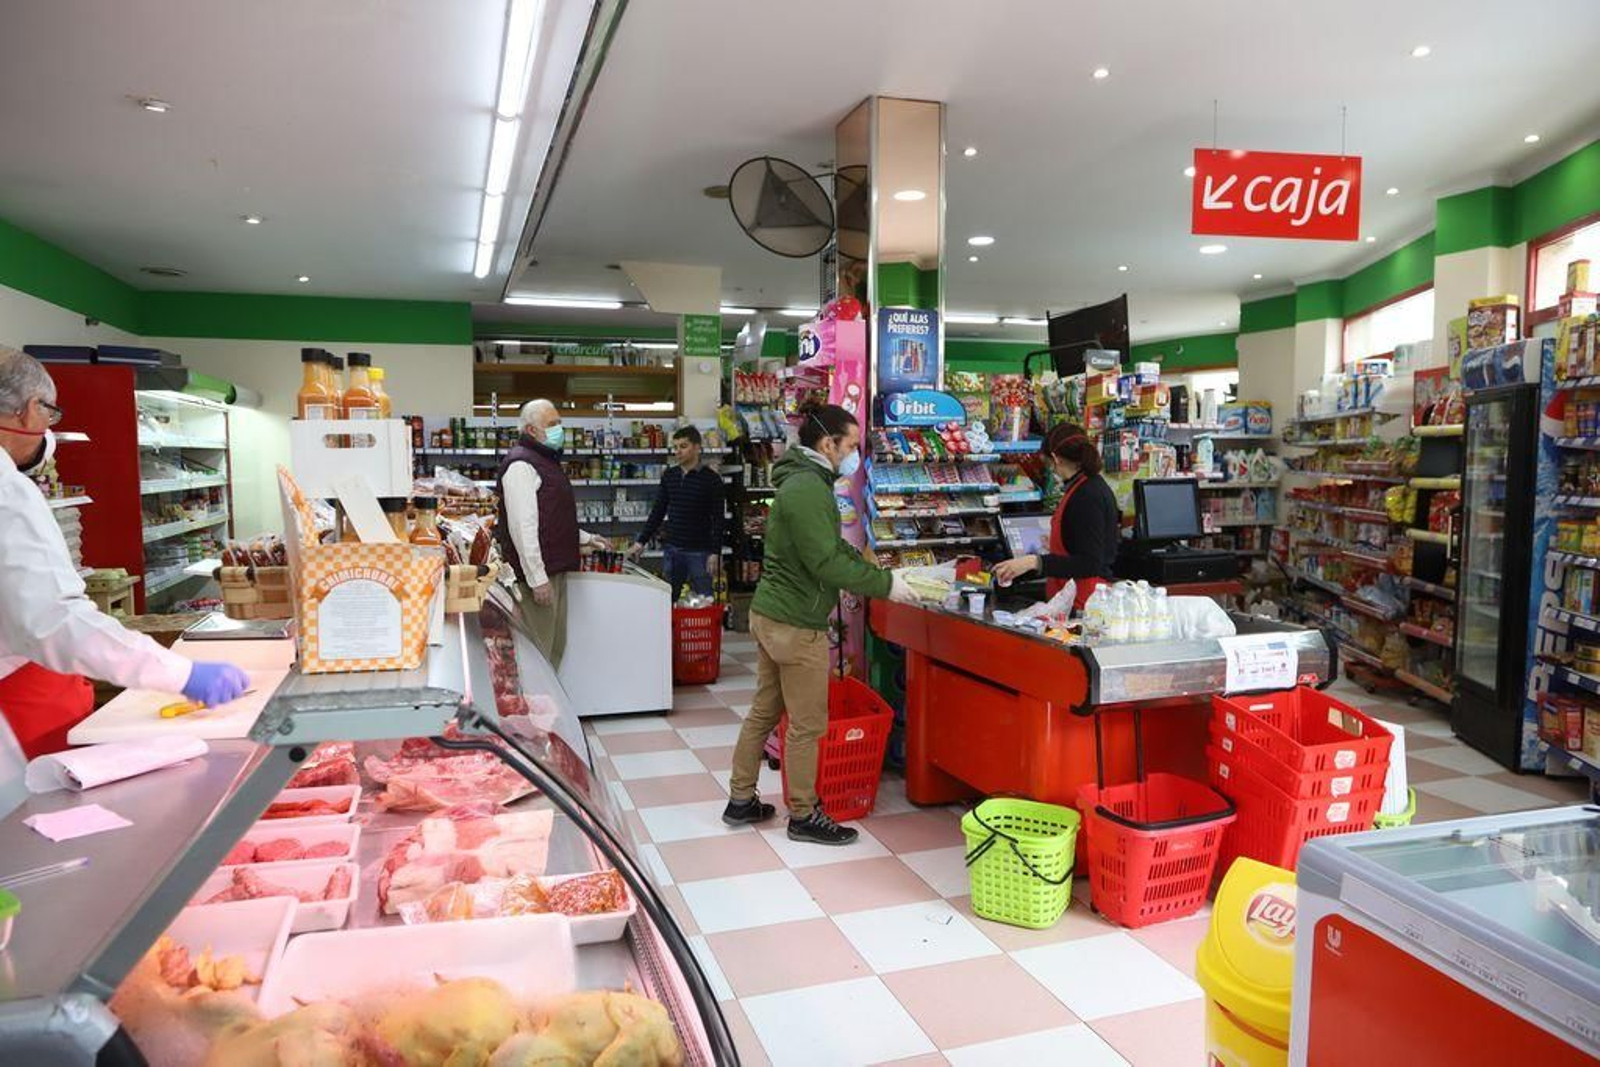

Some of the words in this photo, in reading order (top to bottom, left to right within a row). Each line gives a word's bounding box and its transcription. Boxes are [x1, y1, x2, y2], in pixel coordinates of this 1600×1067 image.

[1243, 167, 1350, 226] caja
[909, 313, 929, 324] ALAS
[890, 400, 937, 415] Orbit
